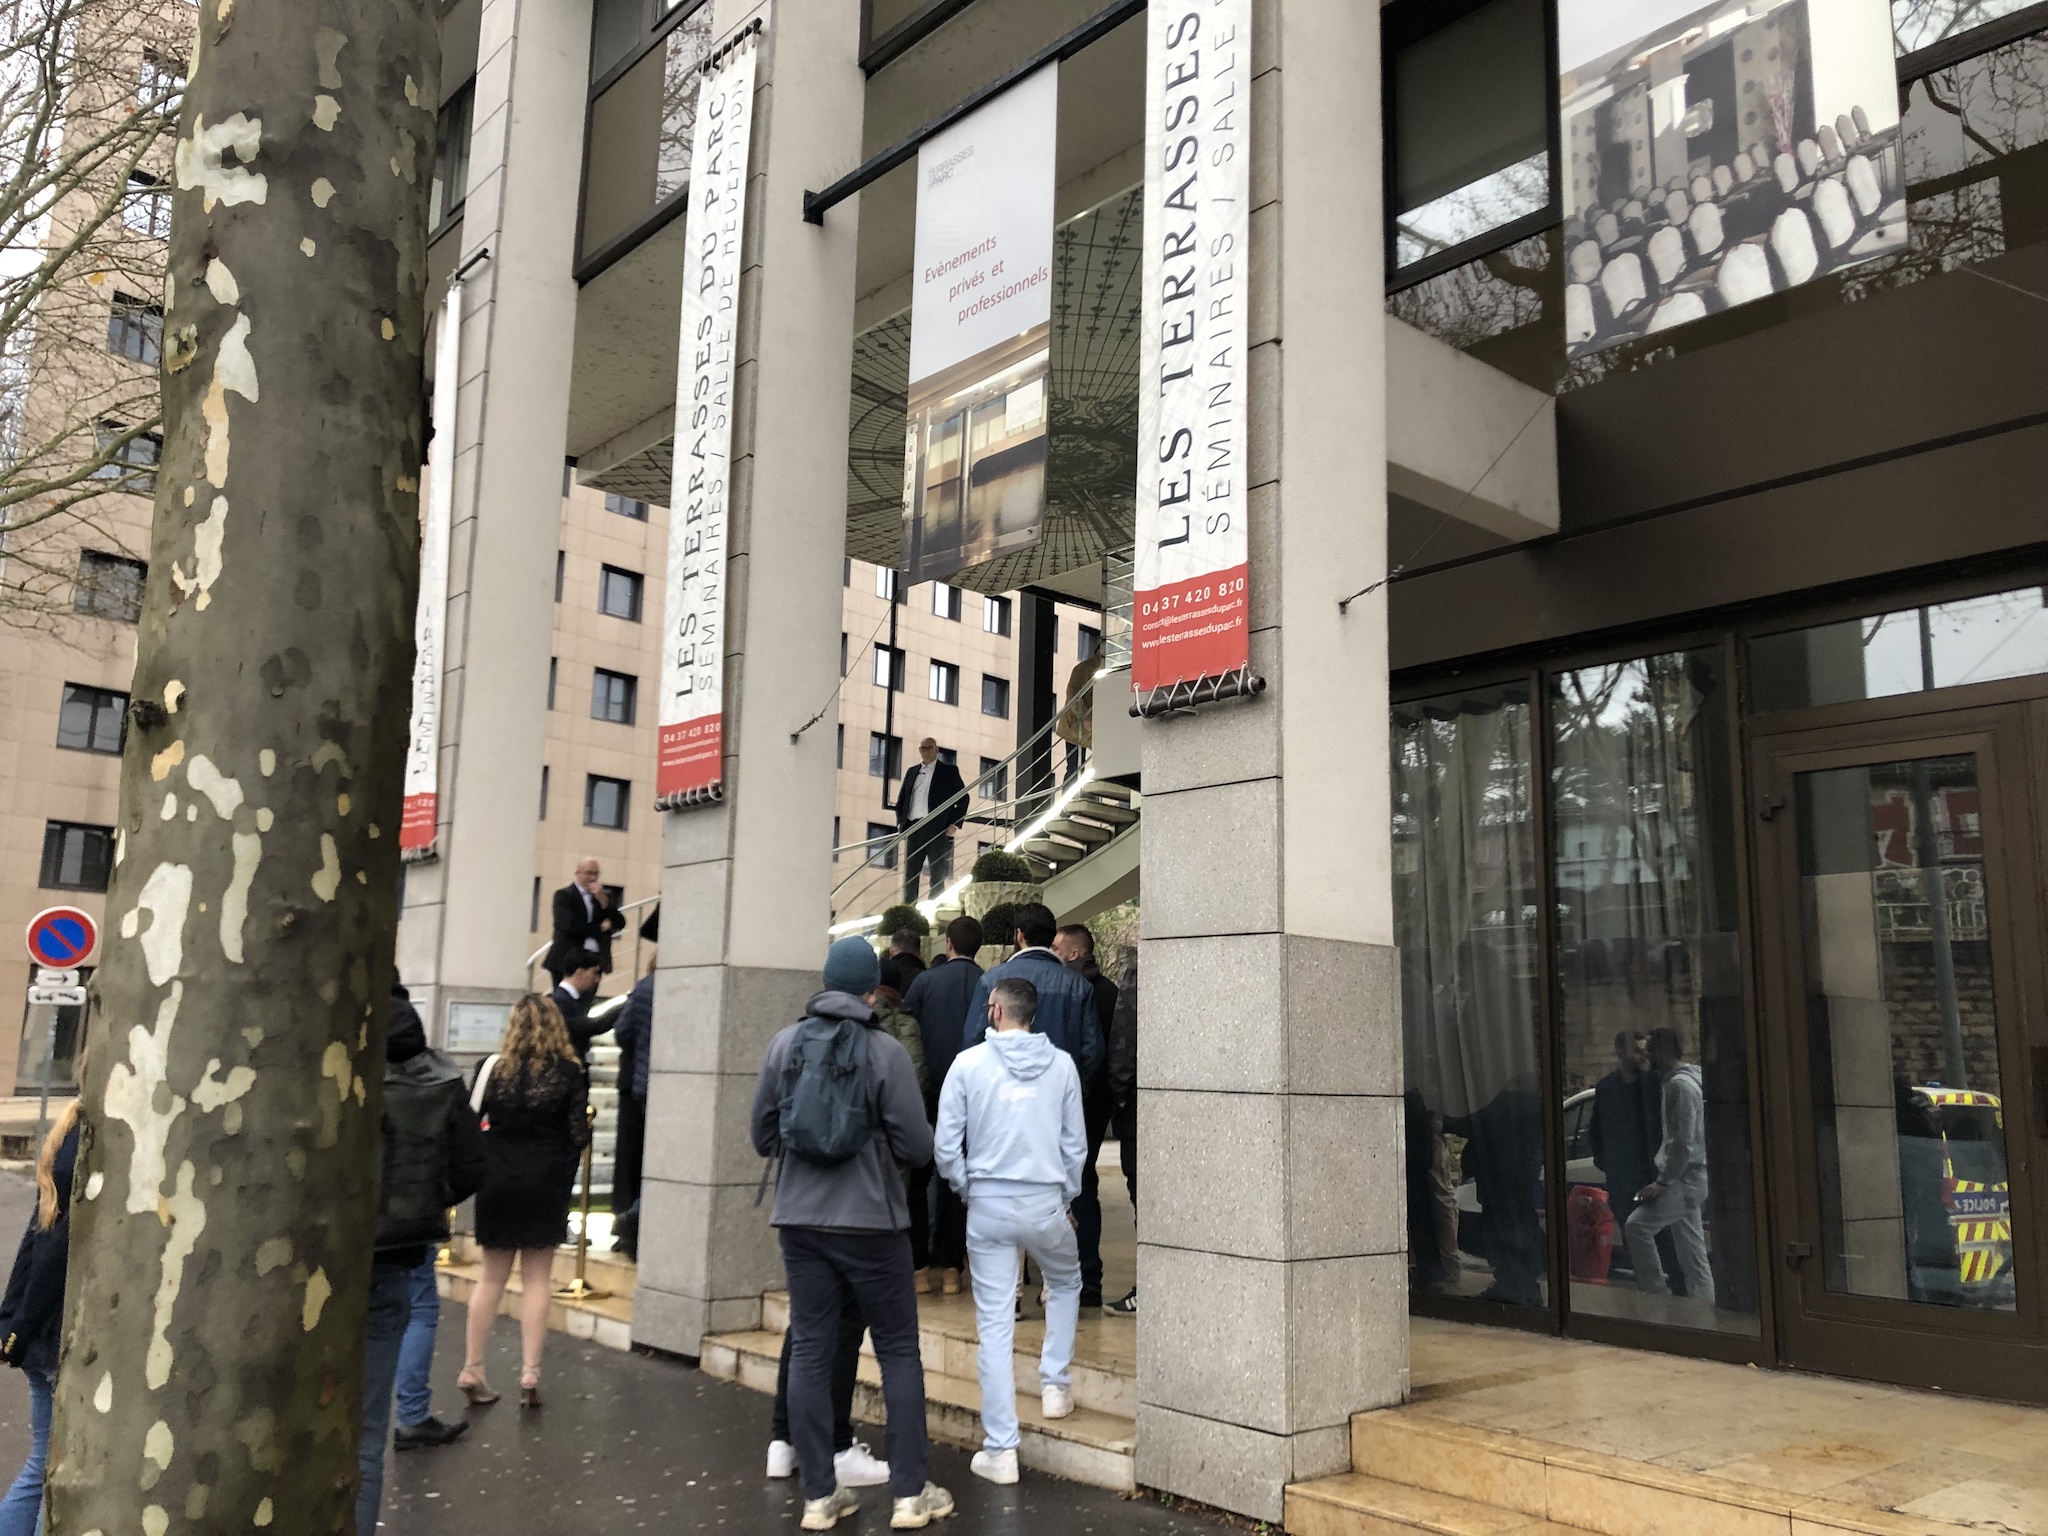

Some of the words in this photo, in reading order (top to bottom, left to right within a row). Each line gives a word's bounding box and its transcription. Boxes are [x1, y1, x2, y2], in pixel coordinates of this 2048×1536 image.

[1212, 24, 1235, 167] SALLE
[704, 92, 726, 213] PARC
[1160, 12, 1201, 398] TERRASSES
[700, 232, 718, 296] DU
[719, 273, 734, 312] DE
[925, 236, 997, 284] Evènements
[949, 270, 985, 302] privés
[991, 259, 1005, 277] et
[958, 266, 1049, 326] professionnels
[712, 330, 731, 430] SALLE
[682, 315, 713, 591] TERRASSES
[1158, 428, 1192, 553] LES
[1184, 586, 1211, 605] 420
[1218, 577, 1244, 597] 820
[676, 613, 697, 698] LES
